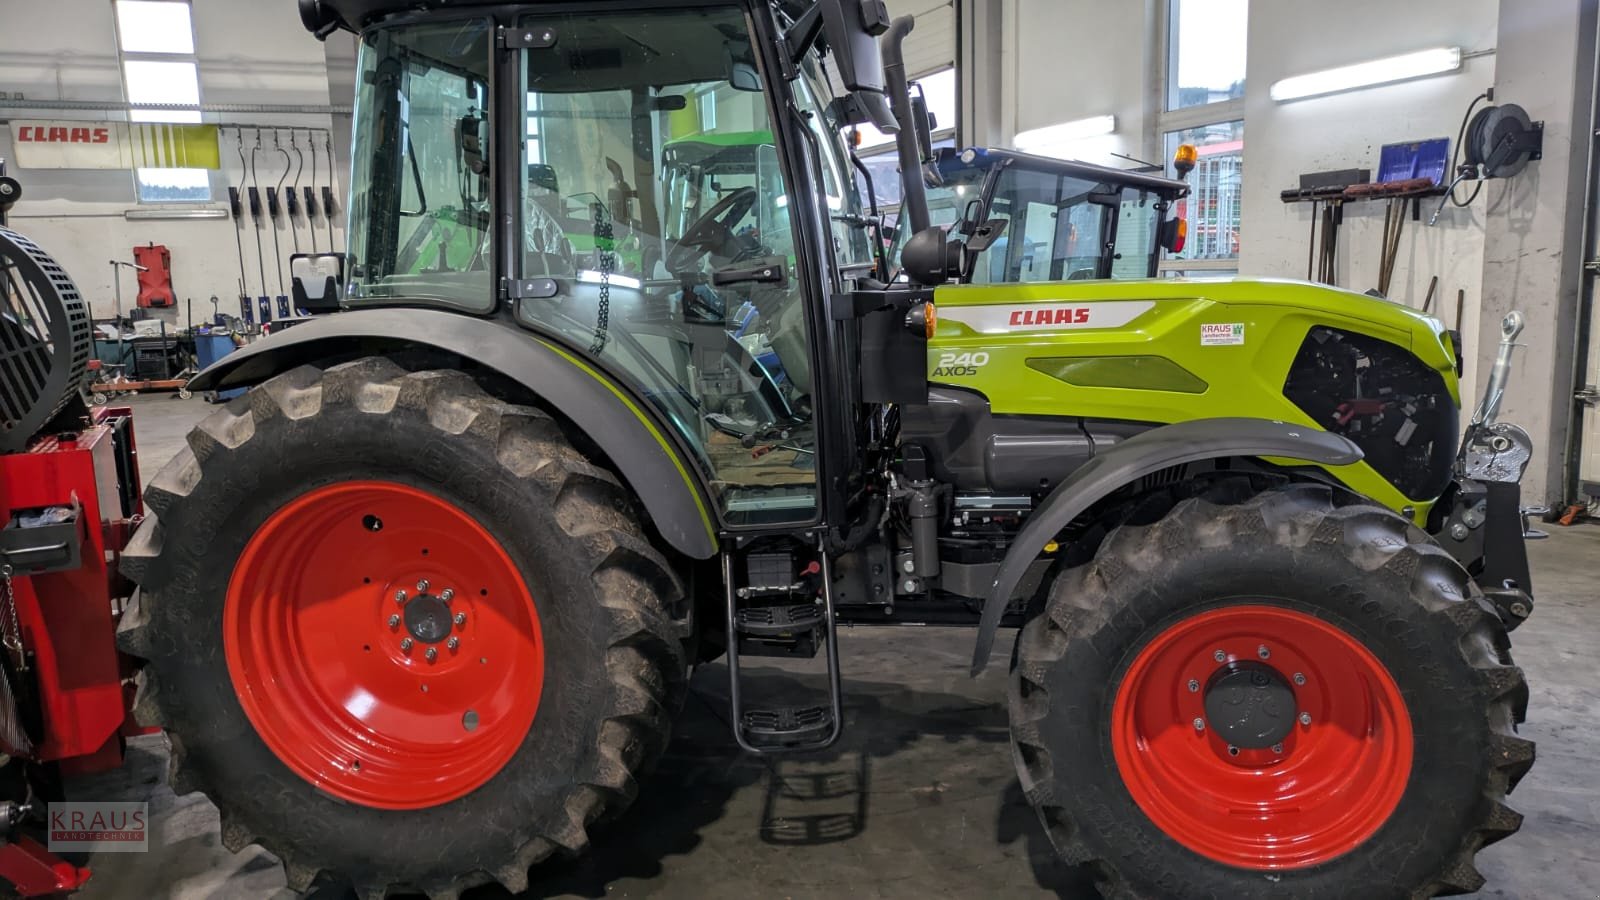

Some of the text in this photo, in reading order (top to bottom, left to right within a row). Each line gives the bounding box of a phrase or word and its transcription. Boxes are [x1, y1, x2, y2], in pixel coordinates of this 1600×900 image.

[18, 127, 108, 142] CLAAS
[1009, 308, 1089, 325] CLAAS
[939, 352, 989, 366] 240
[932, 366, 978, 377] AXOS
